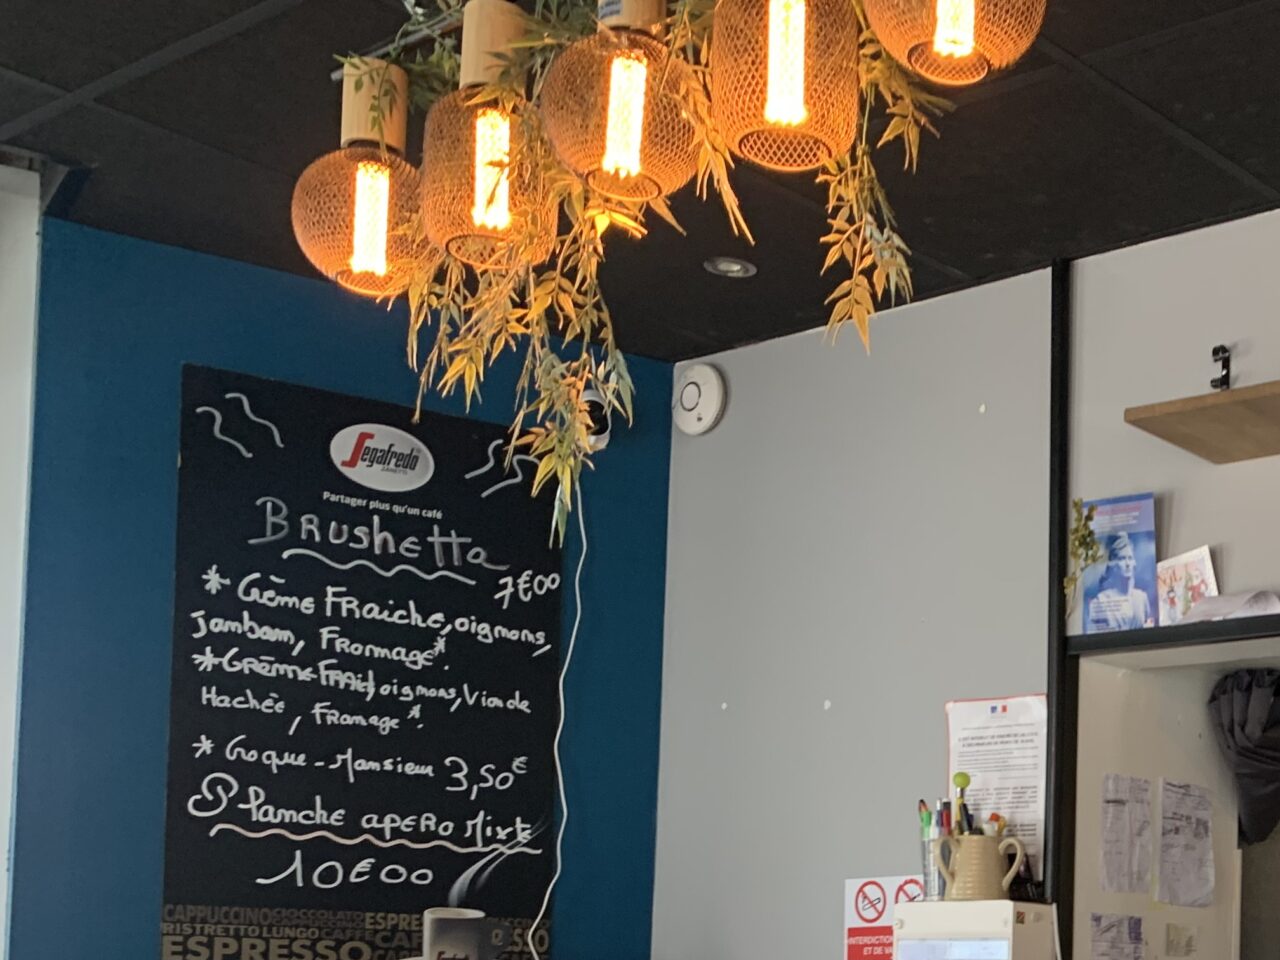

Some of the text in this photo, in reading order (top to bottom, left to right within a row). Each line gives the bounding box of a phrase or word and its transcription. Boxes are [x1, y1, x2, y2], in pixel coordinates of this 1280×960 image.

[340, 432, 420, 472] Segafredo
[323, 491, 443, 520] Partager plus qu'un café
[494, 570, 561, 610] 7€00
[255, 850, 433, 888] 10€00
[164, 904, 272, 926] CAPPUCCINO
[365, 913, 424, 930] ESPRE
[162, 922, 260, 937] RISTRETTO
[262, 927, 320, 940] LUNGO
